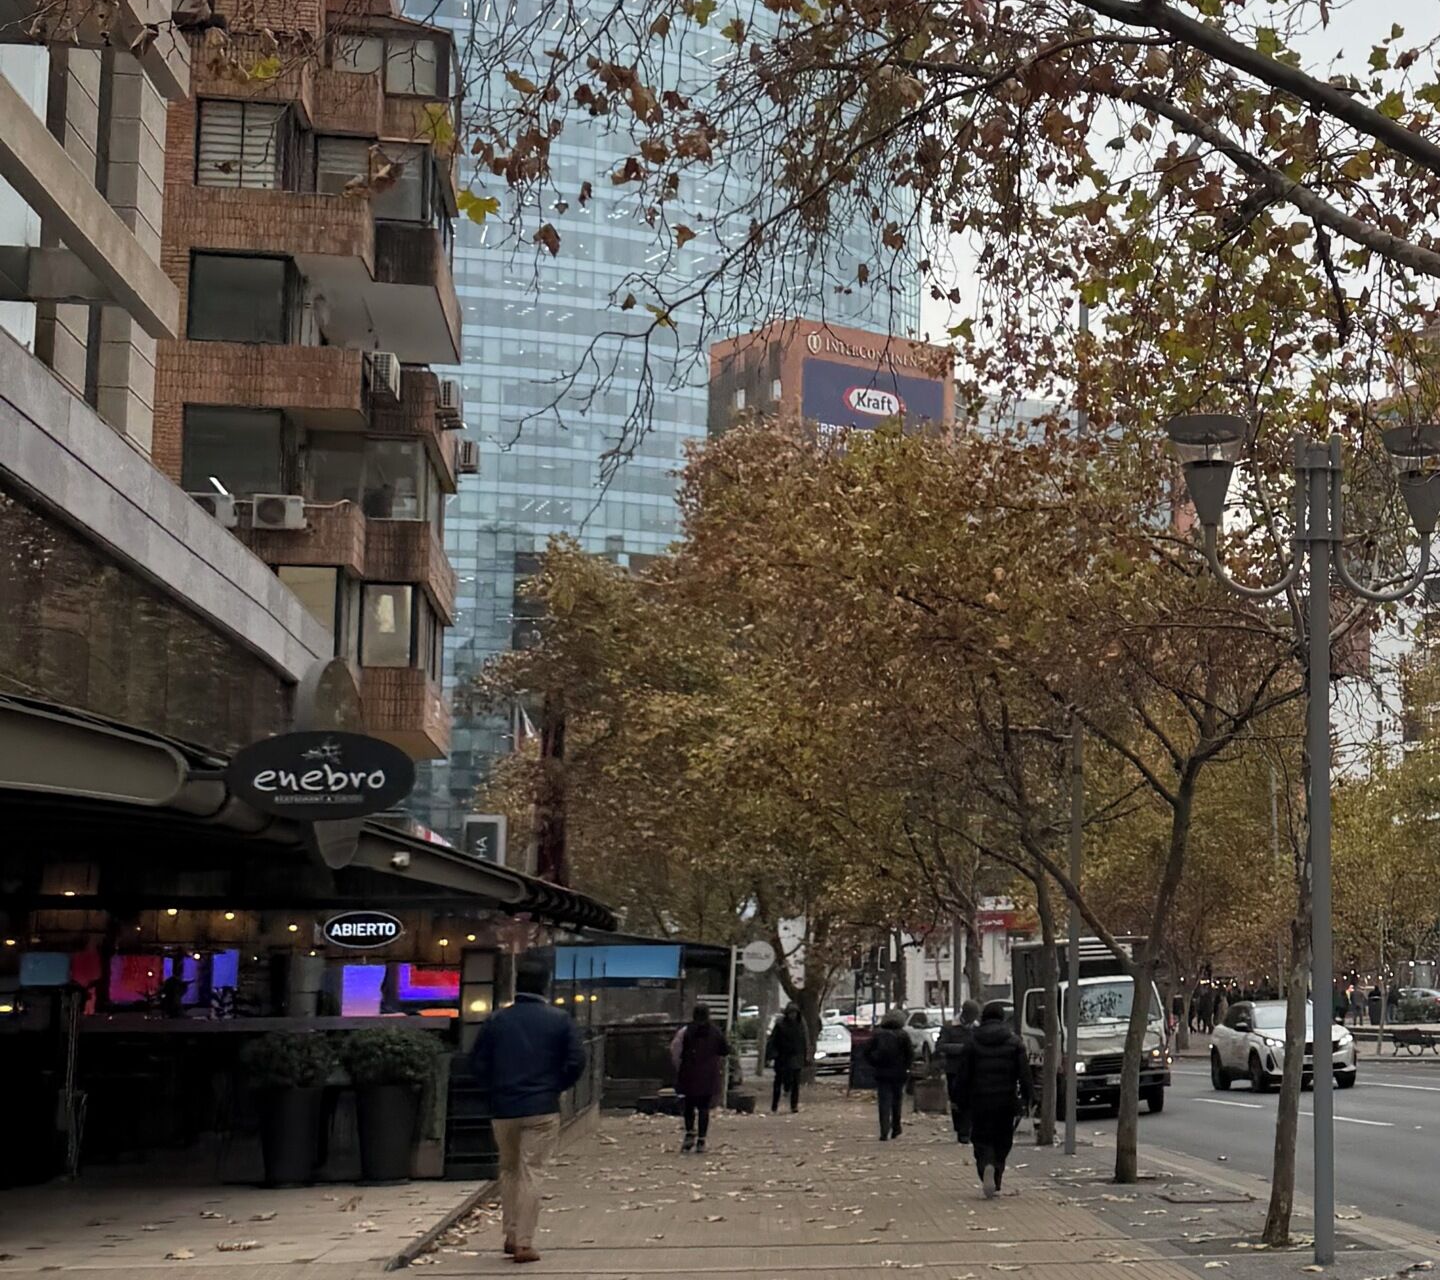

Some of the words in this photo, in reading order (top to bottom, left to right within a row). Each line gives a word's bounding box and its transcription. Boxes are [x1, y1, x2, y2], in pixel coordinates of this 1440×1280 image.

[856, 391, 893, 413] Kraft
[253, 763, 386, 791] enebro
[330, 922, 397, 937] ABIERTO
